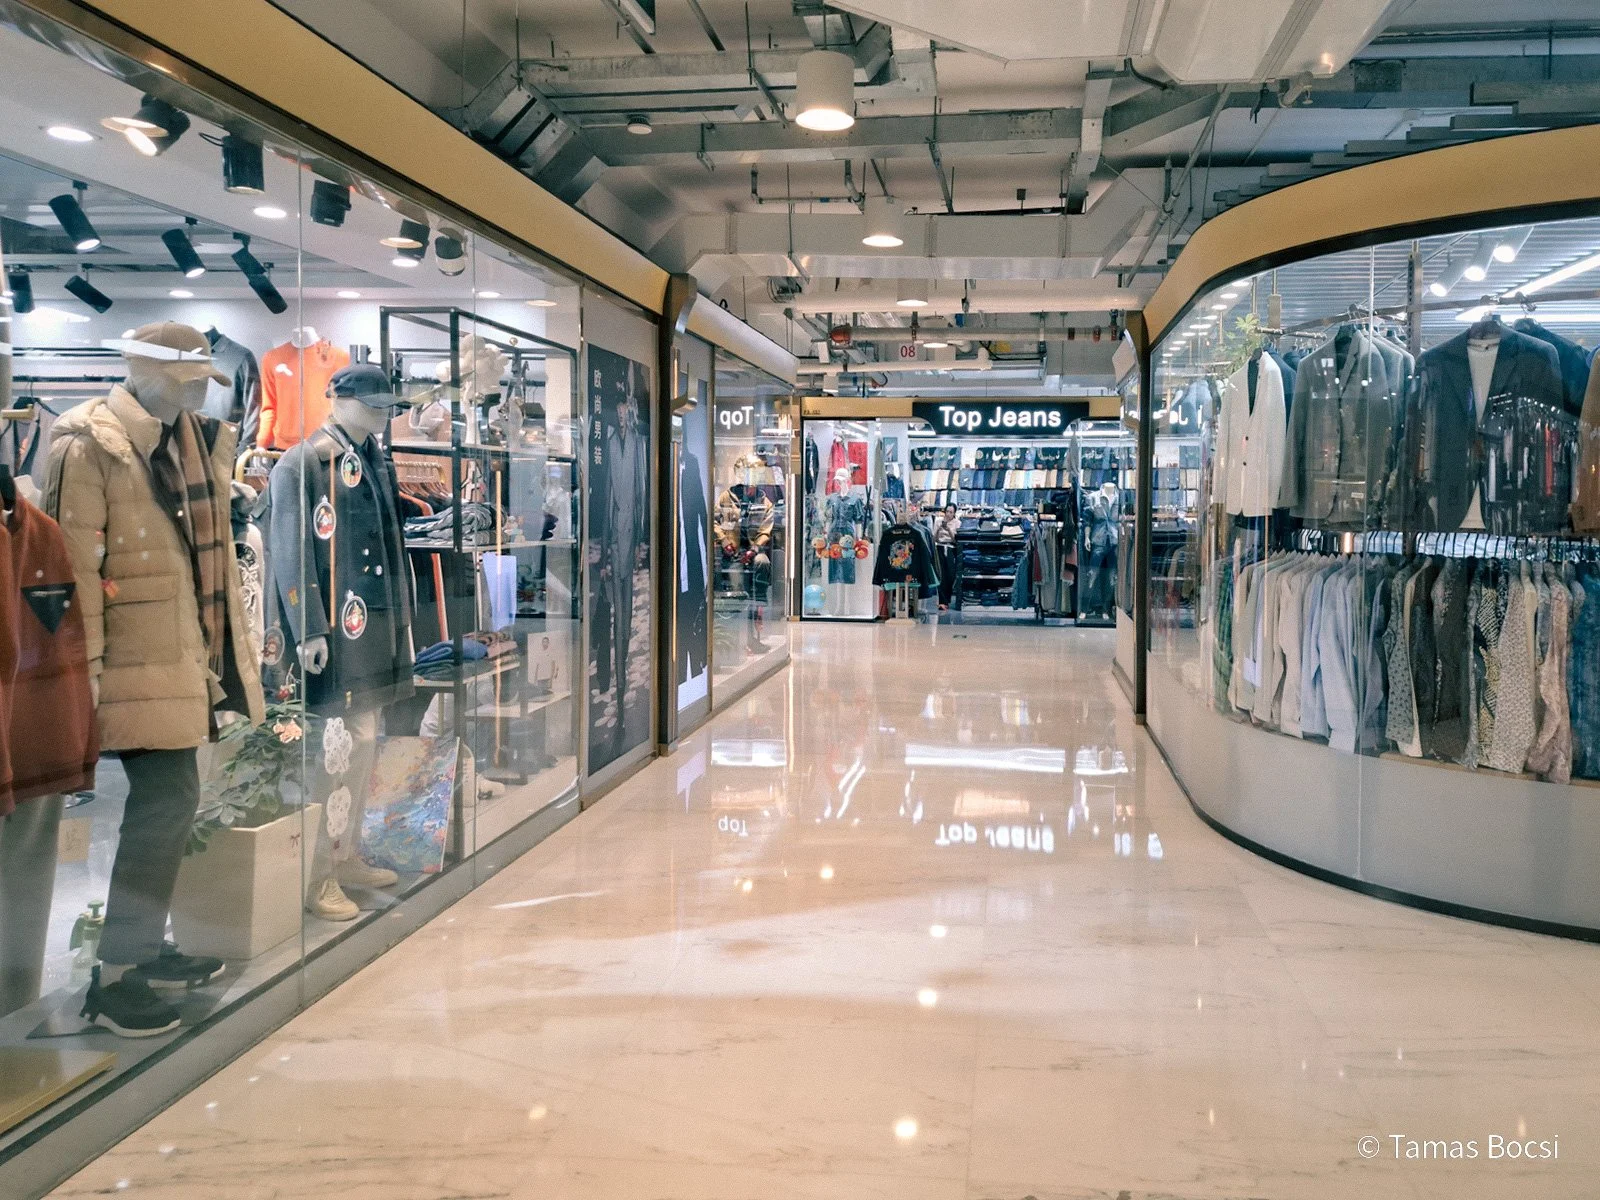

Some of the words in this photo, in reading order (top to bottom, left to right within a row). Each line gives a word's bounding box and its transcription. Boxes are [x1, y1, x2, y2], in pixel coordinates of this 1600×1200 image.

[900, 345, 915, 357] 08
[938, 405, 982, 432] Top
[988, 406, 1062, 428] Jeans
